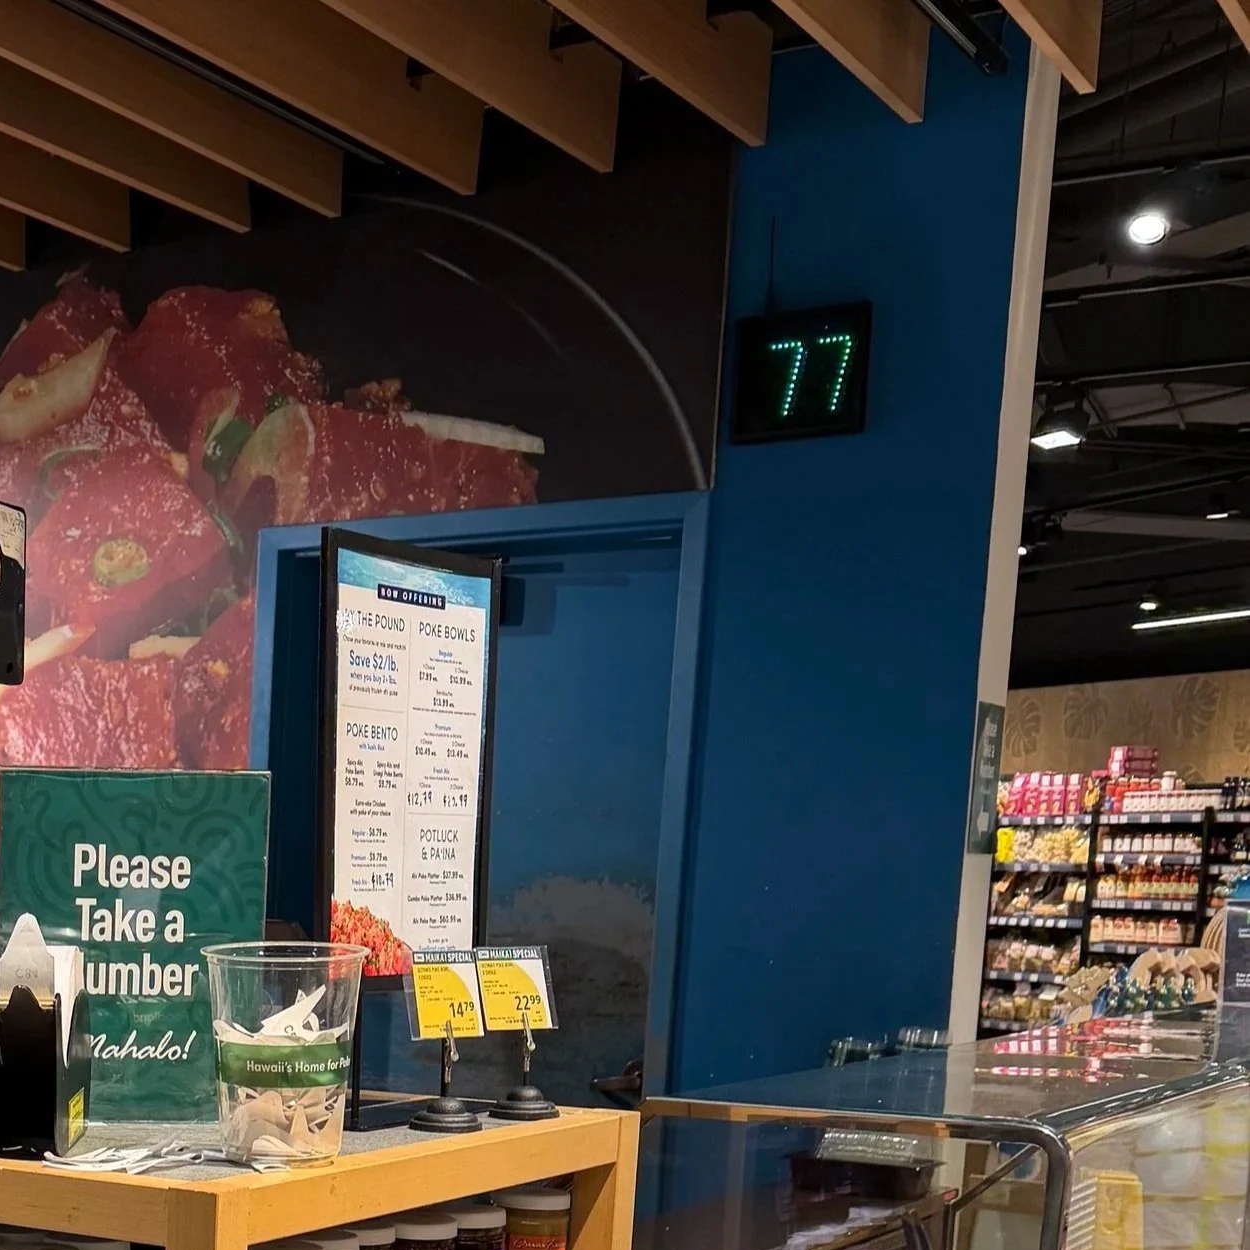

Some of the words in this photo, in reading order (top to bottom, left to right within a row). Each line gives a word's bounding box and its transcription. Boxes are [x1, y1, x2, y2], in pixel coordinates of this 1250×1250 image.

[771, 334, 852, 416] 77
[403, 592, 442, 606] OFFERING
[358, 611, 372, 627] THE
[375, 614, 405, 632] POUND
[419, 622, 442, 638] POKE
[445, 626, 475, 642] BOWLS
[349, 650, 371, 668] Save
[372, 652, 399, 672] $2/lb.
[347, 723, 369, 738] POKE
[371, 725, 398, 741] BENTO
[420, 829, 459, 843] POTLUCK
[422, 847, 428, 860] &
[73, 843, 191, 889] Please
[75, 898, 155, 943] Take
[163, 910, 185, 943] a
[448, 952, 473, 962] SPECIAL
[513, 948, 539, 958] SPECIAL
[86, 953, 199, 996] umber
[247, 1060, 292, 1073] Hawaii's
[295, 1061, 325, 1073] Home
[327, 1059, 338, 1070] for
